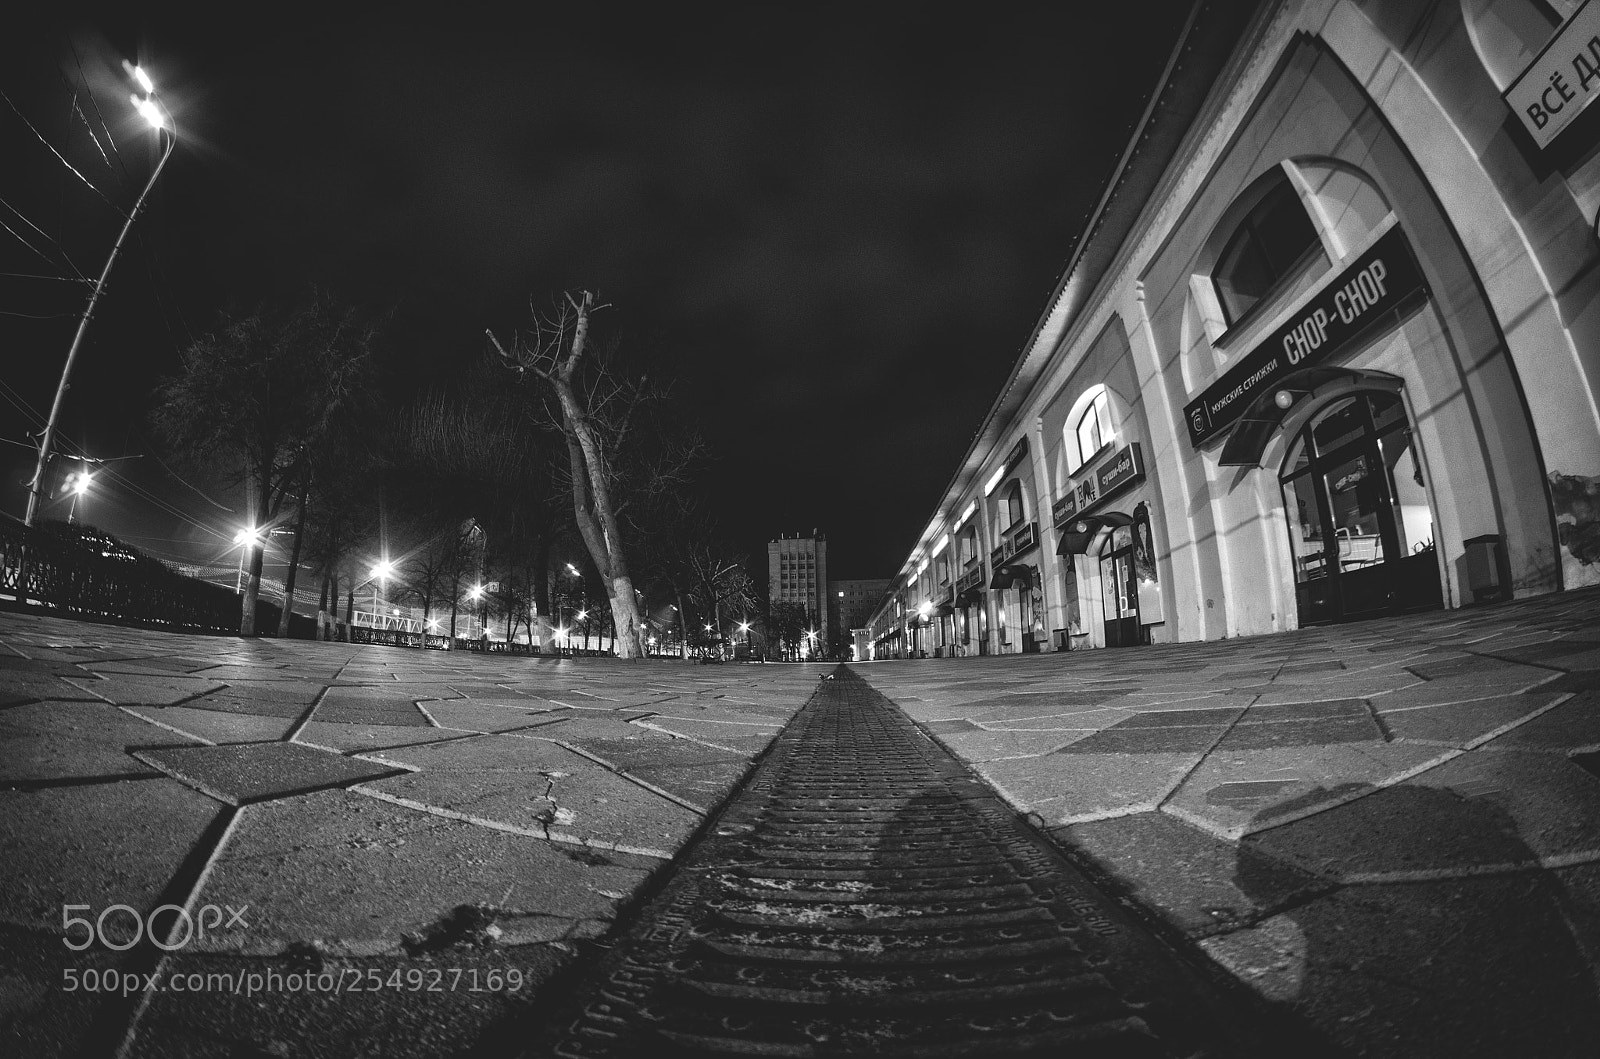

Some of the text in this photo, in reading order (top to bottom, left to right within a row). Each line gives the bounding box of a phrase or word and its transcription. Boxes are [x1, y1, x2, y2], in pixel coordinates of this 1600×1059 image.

[1526, 71, 1576, 130] ВСЁ
[1283, 258, 1387, 365] CHOP-CHOP
[1211, 358, 1279, 415] МУЖСКИЕ СТРИЖКИ
[1102, 457, 1131, 486] суши-бар
